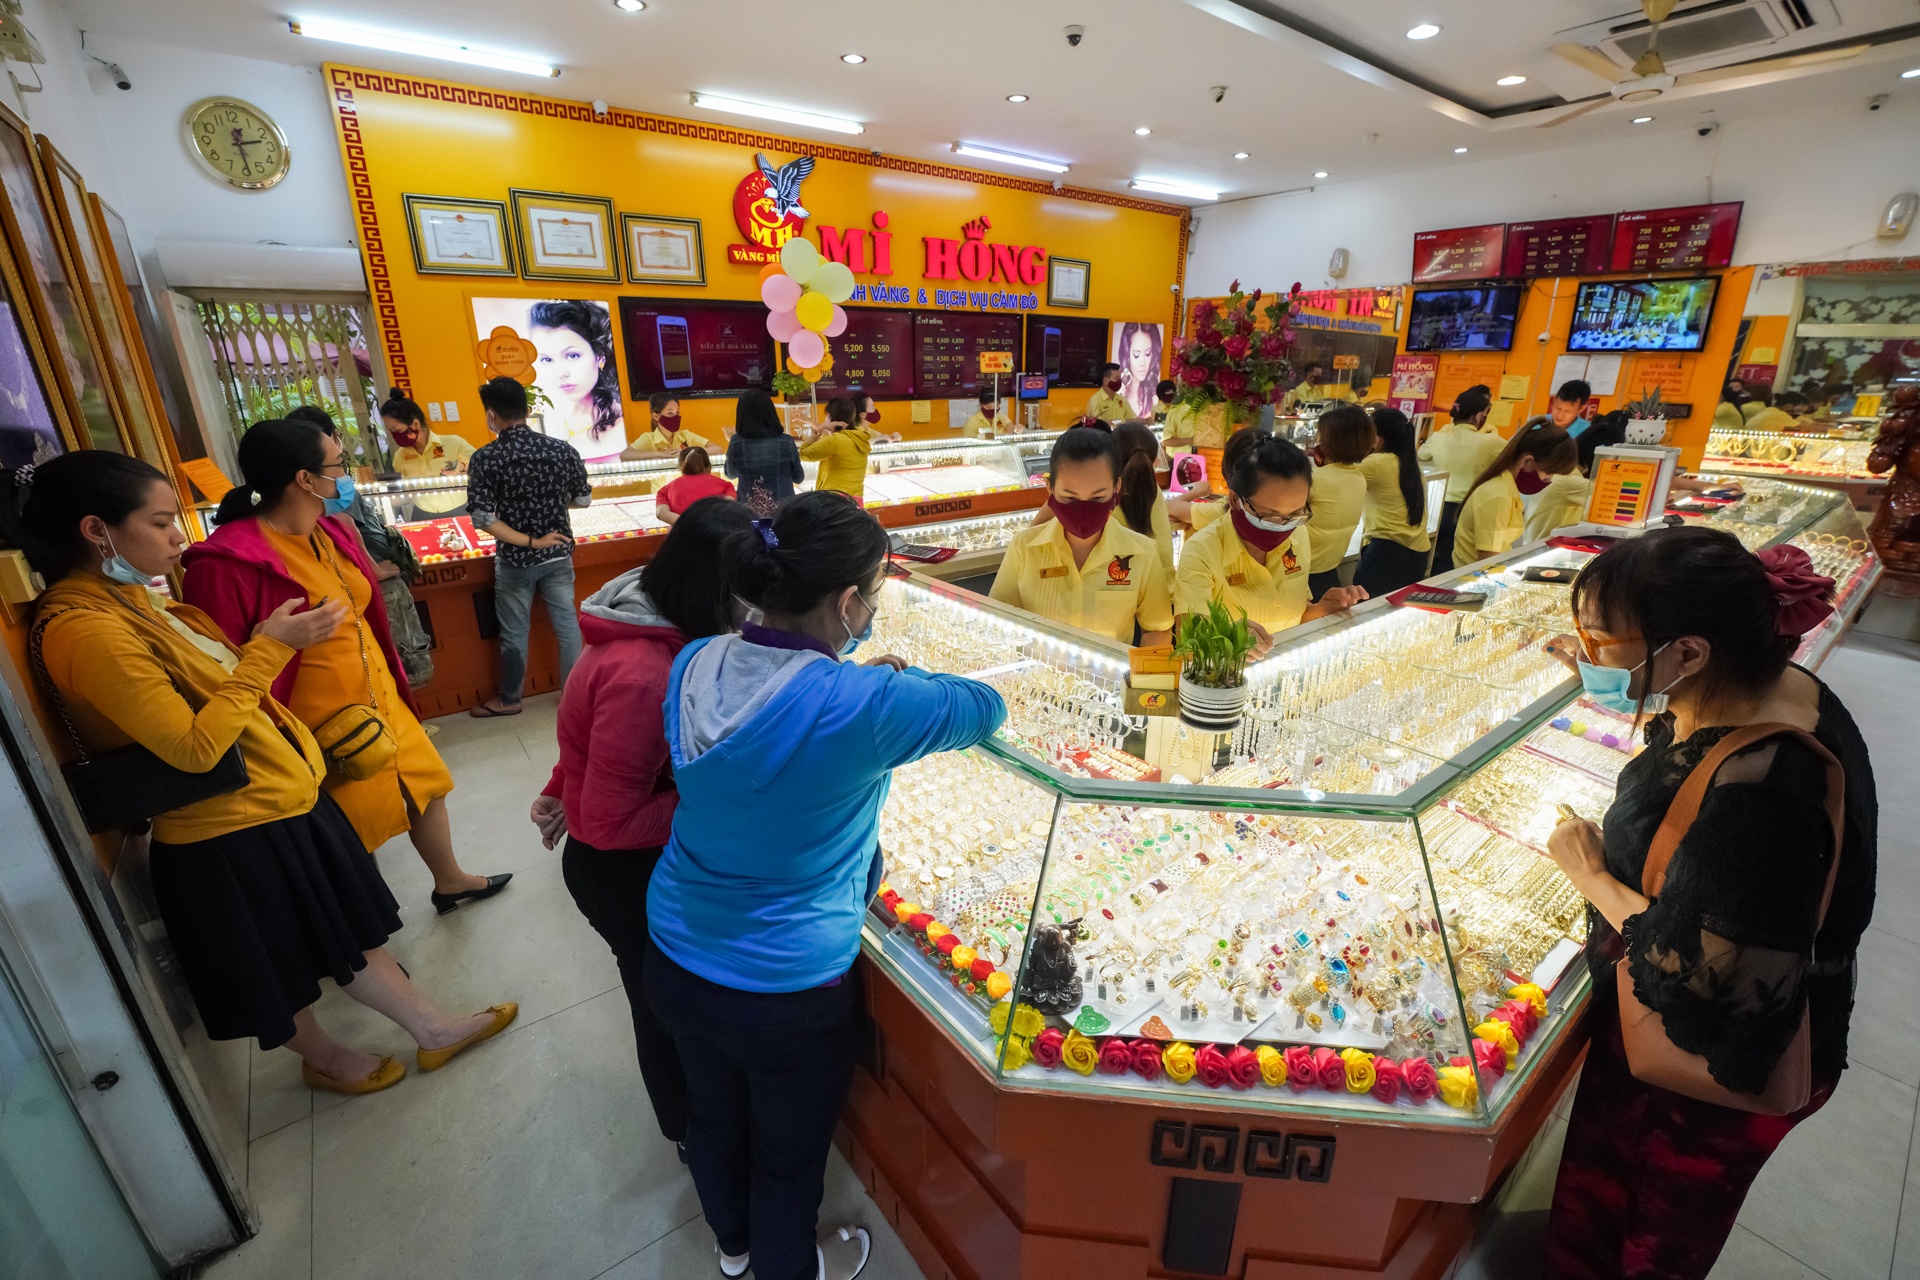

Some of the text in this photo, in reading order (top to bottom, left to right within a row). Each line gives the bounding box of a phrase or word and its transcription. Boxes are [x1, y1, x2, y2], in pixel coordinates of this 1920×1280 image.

[214, 114, 224, 126] 11
[225, 110, 239, 123] 12
[202, 122, 215, 134] 10
[246, 118, 251, 129] 1
[257, 127, 267, 139] 2
[201, 135, 212, 147] 9
[266, 141, 275, 152] 3
[210, 149, 220, 161] 8
[265, 154, 274, 165] 4
[225, 159, 233, 171] 7
[254, 162, 265, 173] 5
[748, 217, 794, 249] MH
[733, 248, 764, 262] VÀNG
[870, 281, 911, 303] VÀNG
[917, 287, 928, 305] &
[936, 289, 967, 310] DỊCH
[970, 291, 988, 311] VỤ
[844, 344, 889, 353] 5,200 5,550
[845, 370, 864, 378] 4,800
[872, 370, 890, 378] 5,050
[1402, 403, 1411, 411] 12
